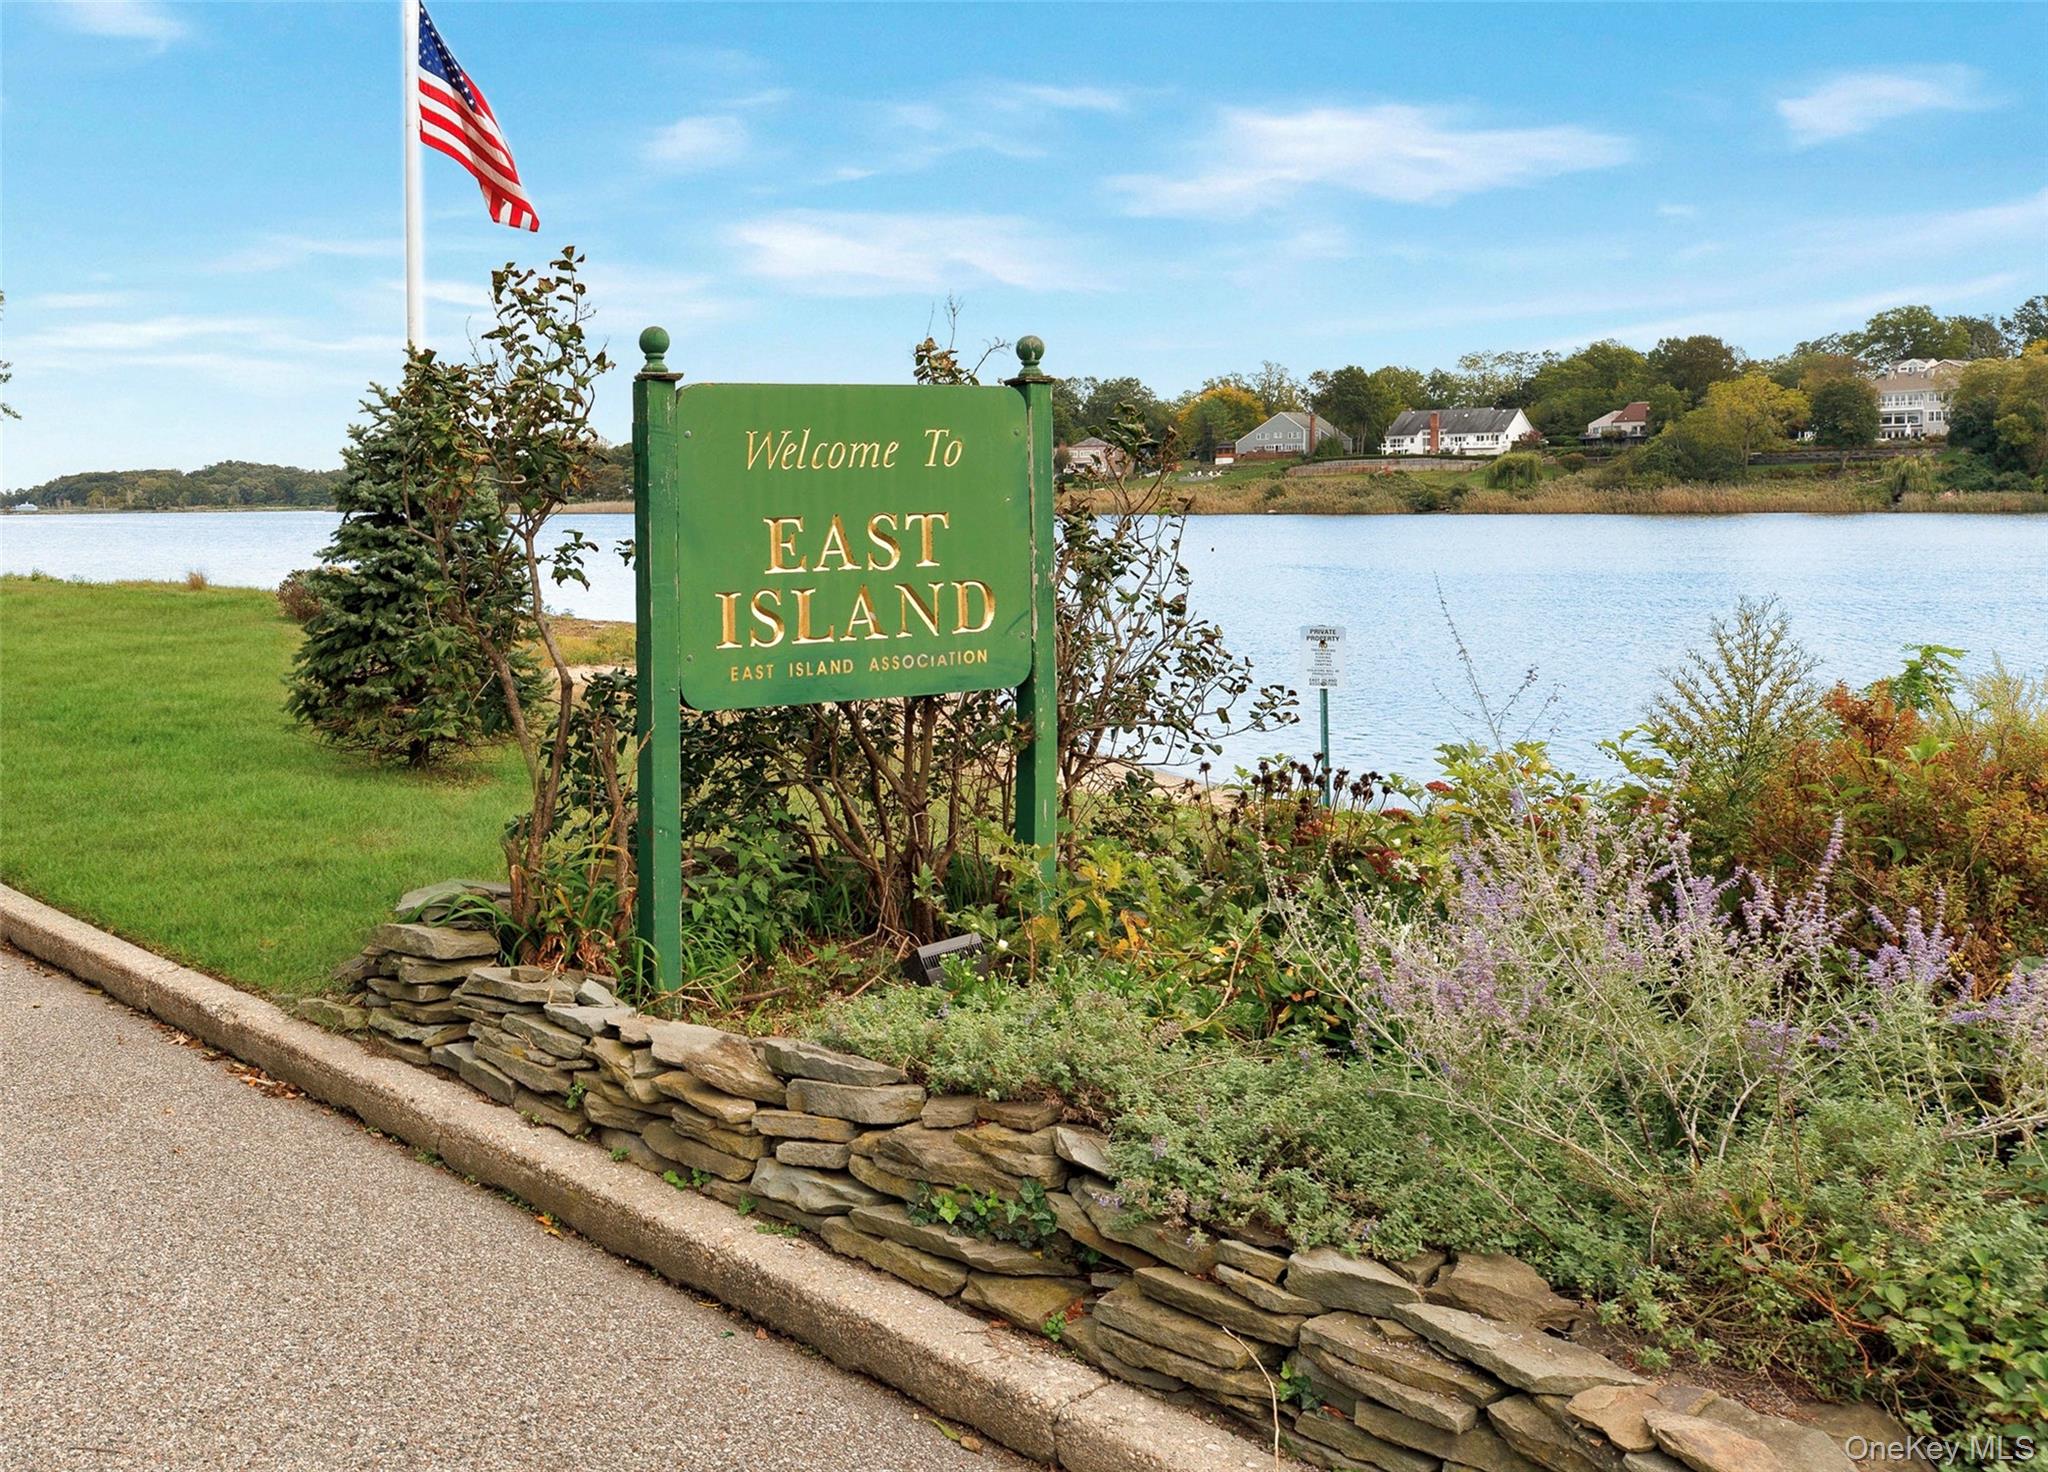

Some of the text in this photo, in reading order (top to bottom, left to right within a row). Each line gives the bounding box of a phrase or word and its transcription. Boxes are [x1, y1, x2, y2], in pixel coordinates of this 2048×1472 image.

[746, 427, 963, 470] Welcome To
[763, 511, 949, 574] EAST
[715, 580, 996, 649] ISLAND
[731, 649, 989, 682] EAST ISLAND ASSOCIATION
